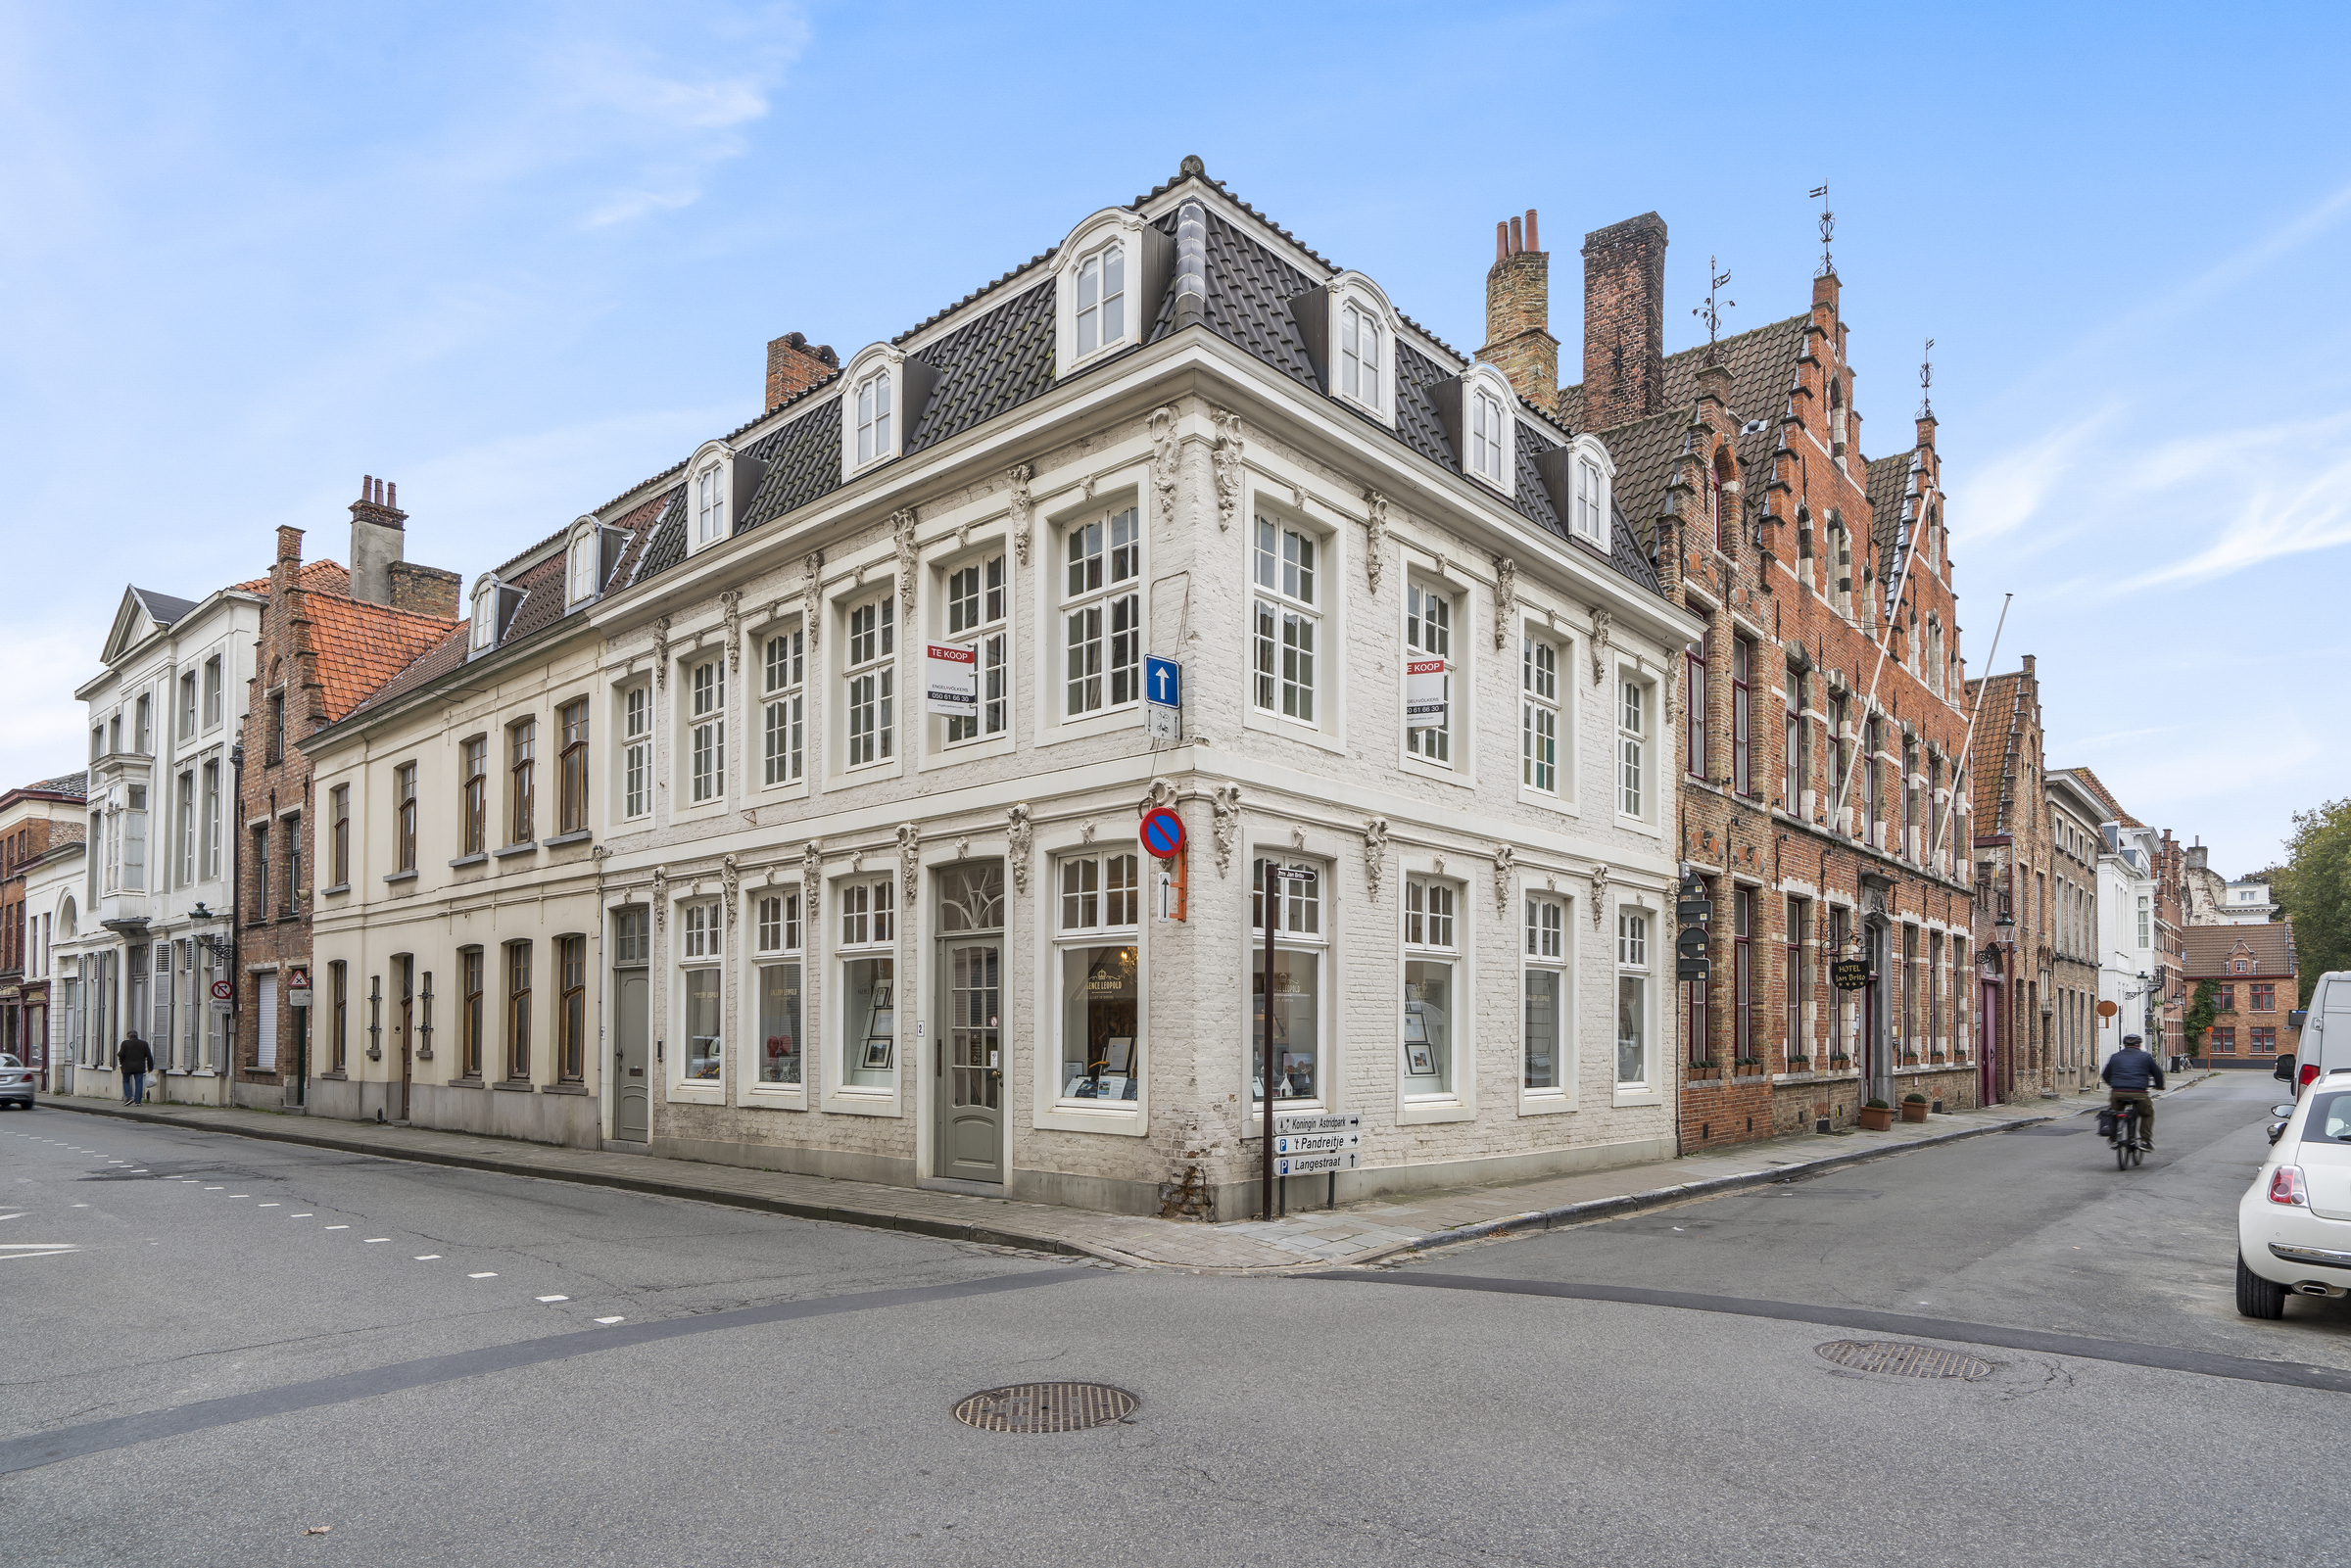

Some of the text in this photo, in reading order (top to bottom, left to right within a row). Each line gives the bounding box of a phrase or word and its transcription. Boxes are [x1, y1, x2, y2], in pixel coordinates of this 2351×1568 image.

[932, 647, 969, 661] TE KOOP
[1414, 662, 1440, 672] KOOP
[1101, 980, 1123, 990] LEOPOLD
[918, 1023, 923, 1033] 2
[1291, 1117, 1346, 1132] Koningin Astridpark
[1293, 1137, 1299, 1150] 't
[1301, 1135, 1344, 1150] Pandreitje
[1295, 1157, 1341, 1171] Langestraat
